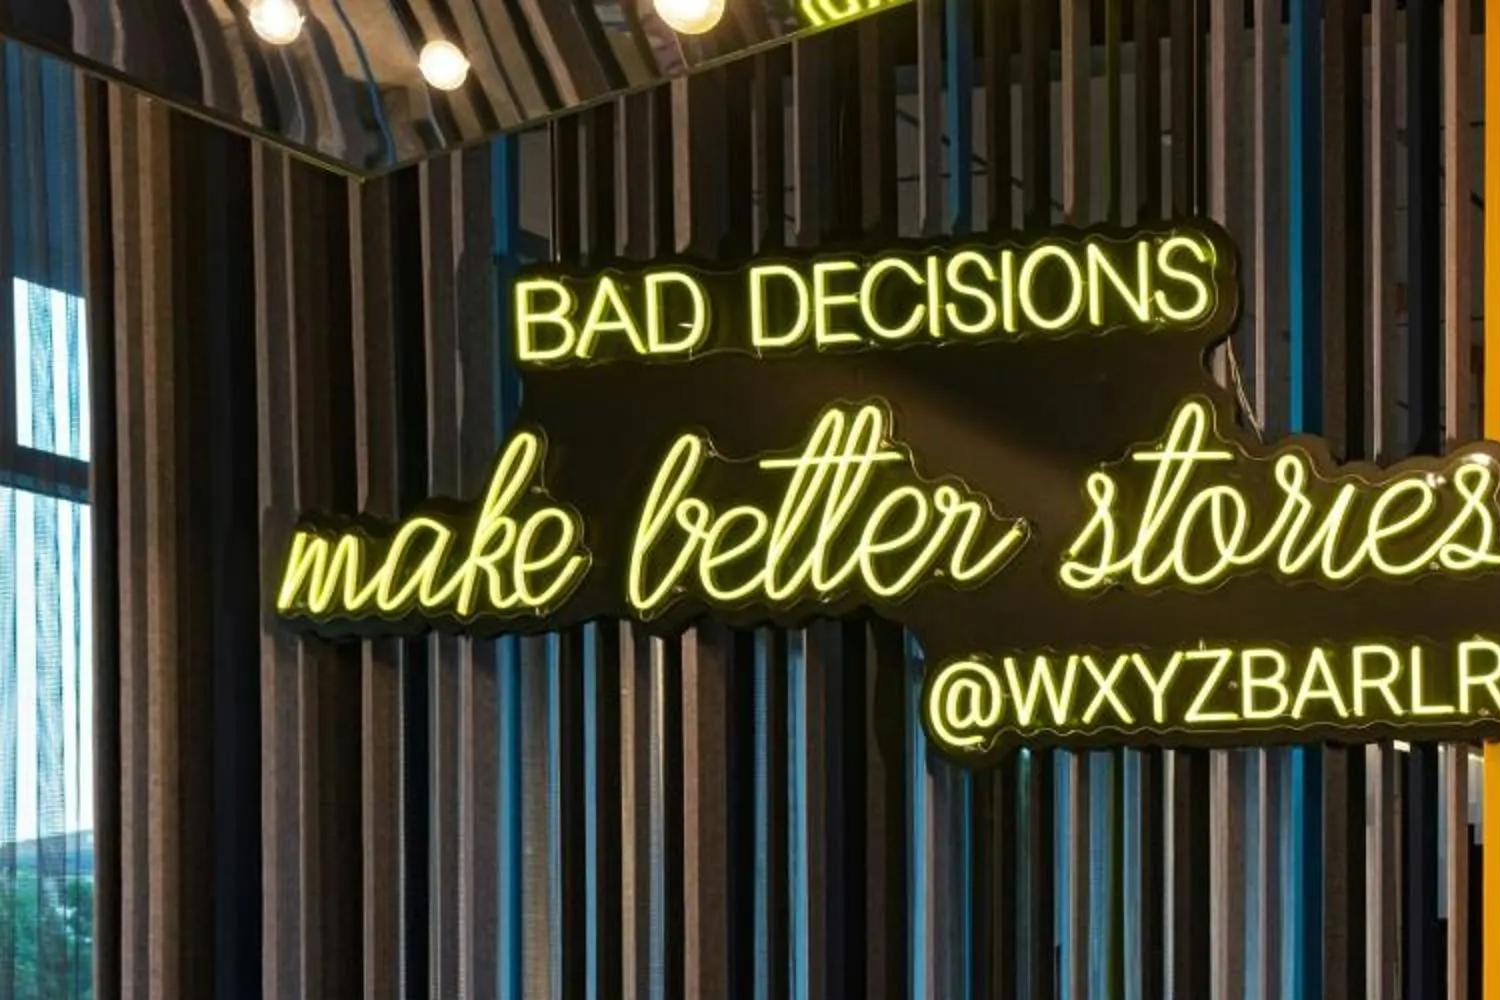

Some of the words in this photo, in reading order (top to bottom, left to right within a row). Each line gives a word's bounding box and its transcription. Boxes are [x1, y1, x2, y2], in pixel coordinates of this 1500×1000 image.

[514, 269, 708, 361] BAD
[748, 234, 1214, 349] DECISIONS
[276, 430, 588, 617] make
[627, 402, 1026, 612] better
